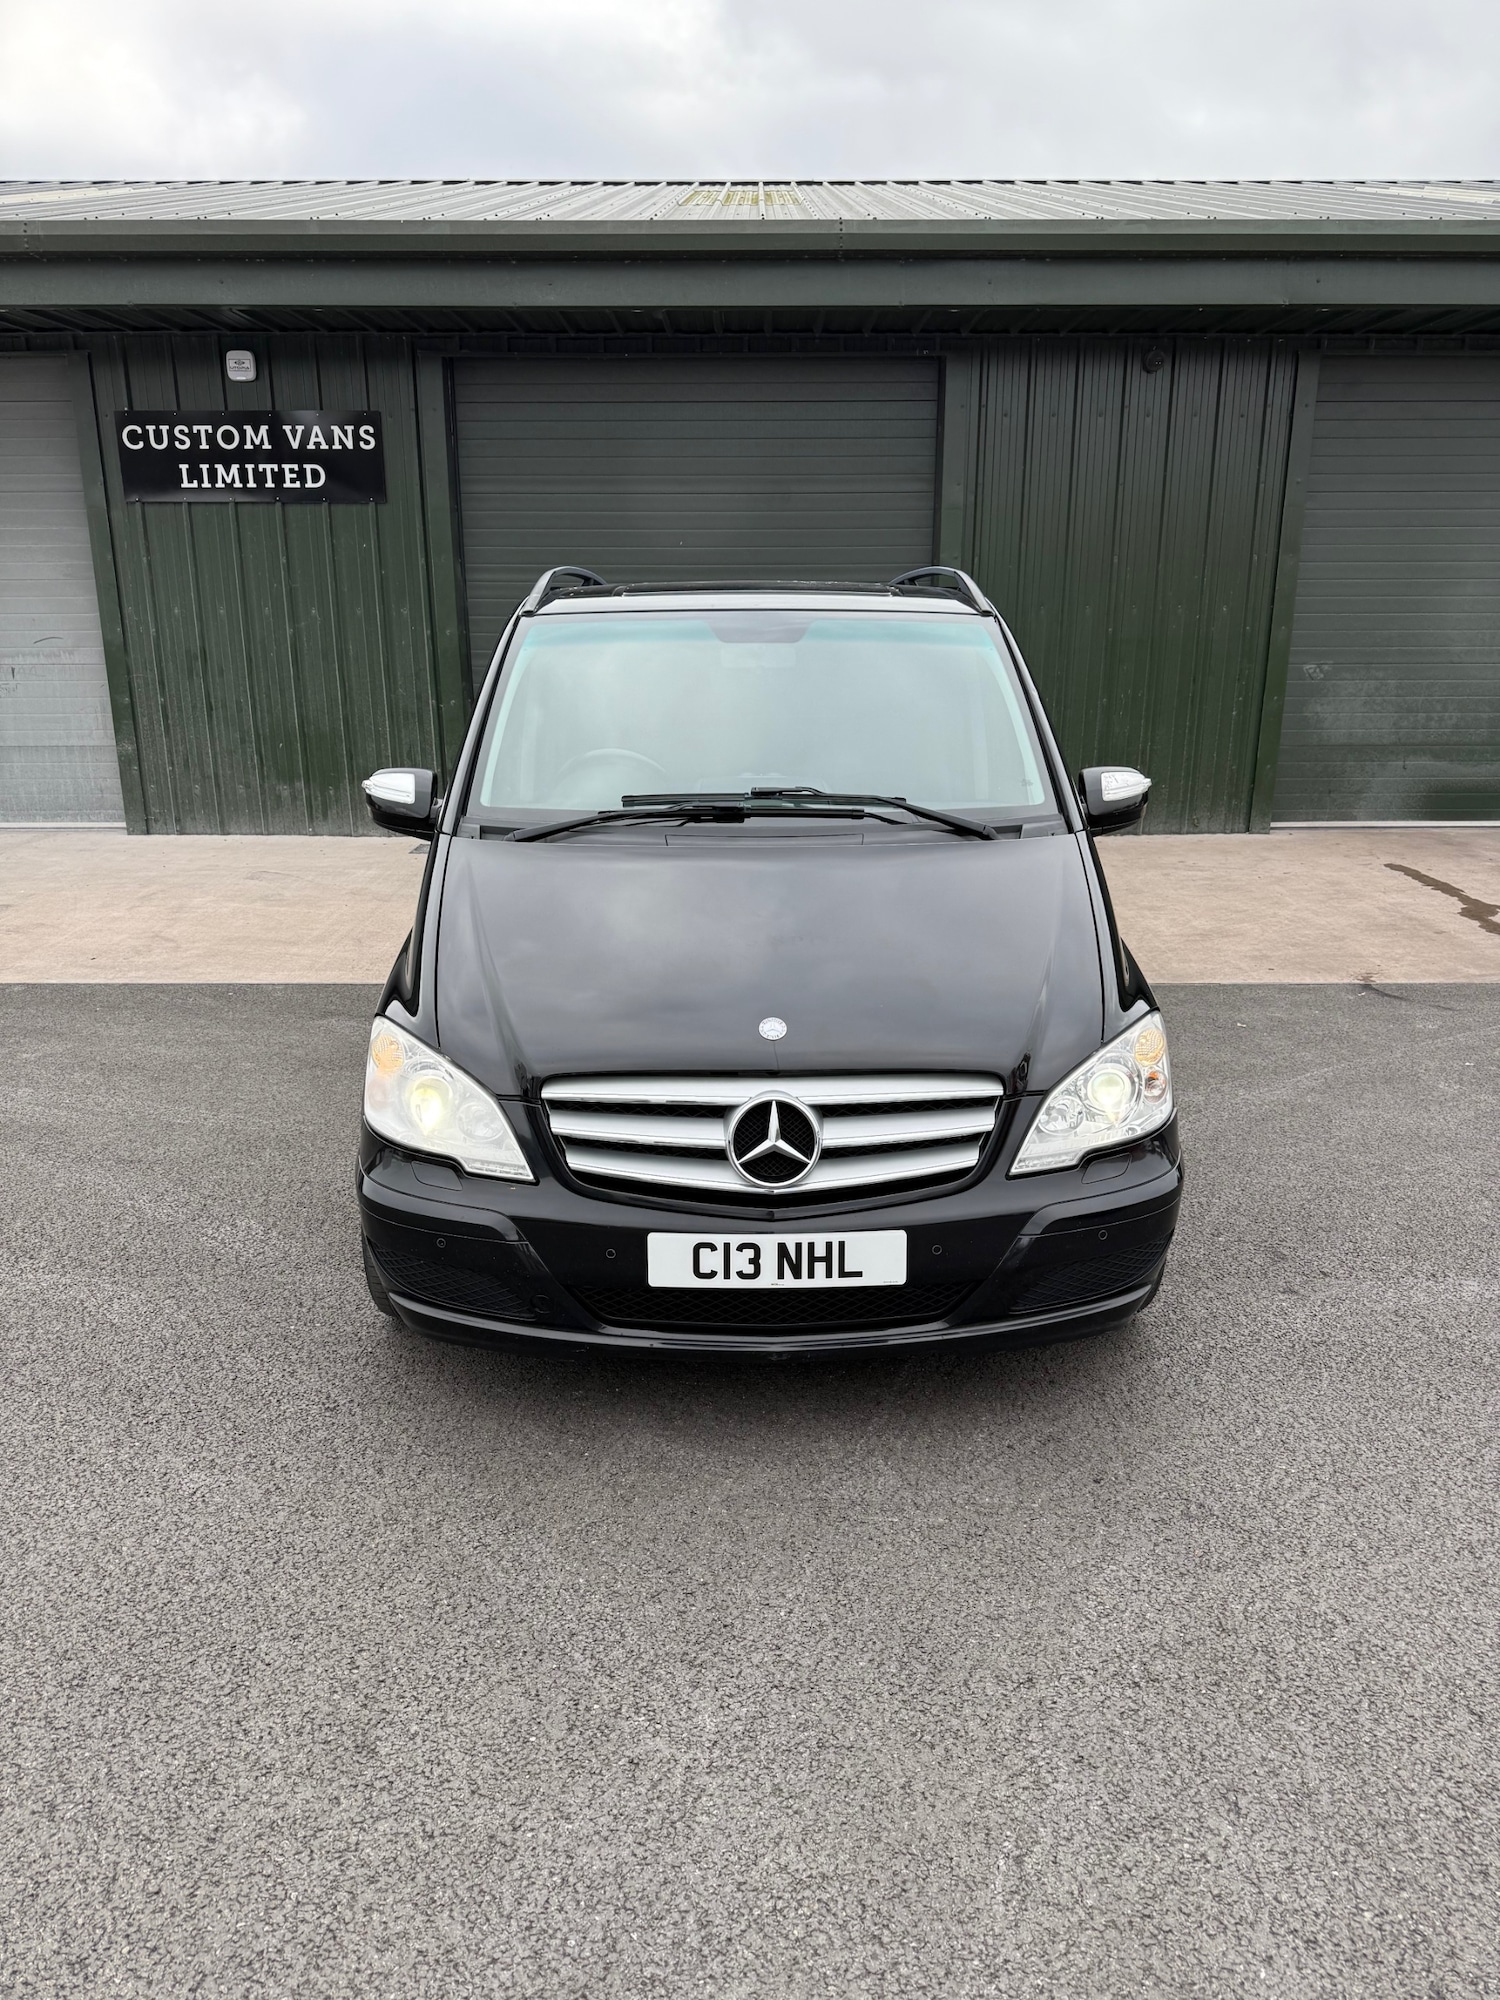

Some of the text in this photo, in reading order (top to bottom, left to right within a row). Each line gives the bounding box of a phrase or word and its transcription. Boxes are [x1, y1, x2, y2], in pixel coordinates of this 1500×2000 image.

[121, 424, 376, 450] CUSTOM VANS
[178, 463, 326, 488] LIMITED
[692, 1240, 863, 1280] C13 NHL
